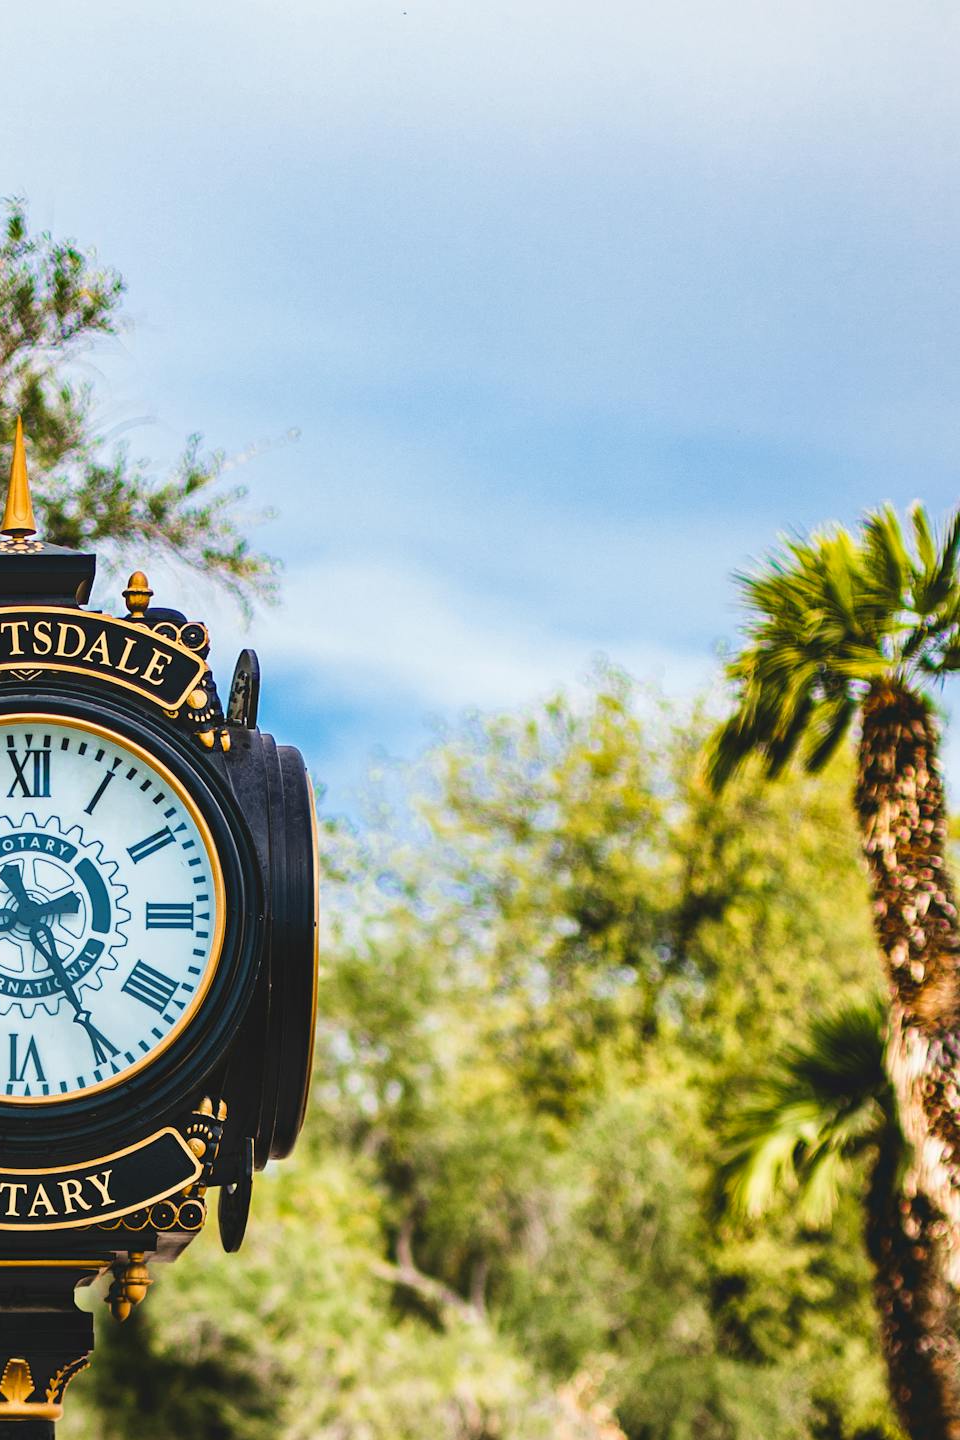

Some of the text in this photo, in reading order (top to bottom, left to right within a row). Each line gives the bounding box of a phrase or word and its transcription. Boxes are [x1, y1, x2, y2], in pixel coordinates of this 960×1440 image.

[6, 750, 52, 798] XII
[84, 770, 116, 816] I
[126, 825, 176, 864] II
[145, 902, 194, 930] III
[121, 959, 180, 1014] IIII
[8, 1033, 47, 1082] VI
